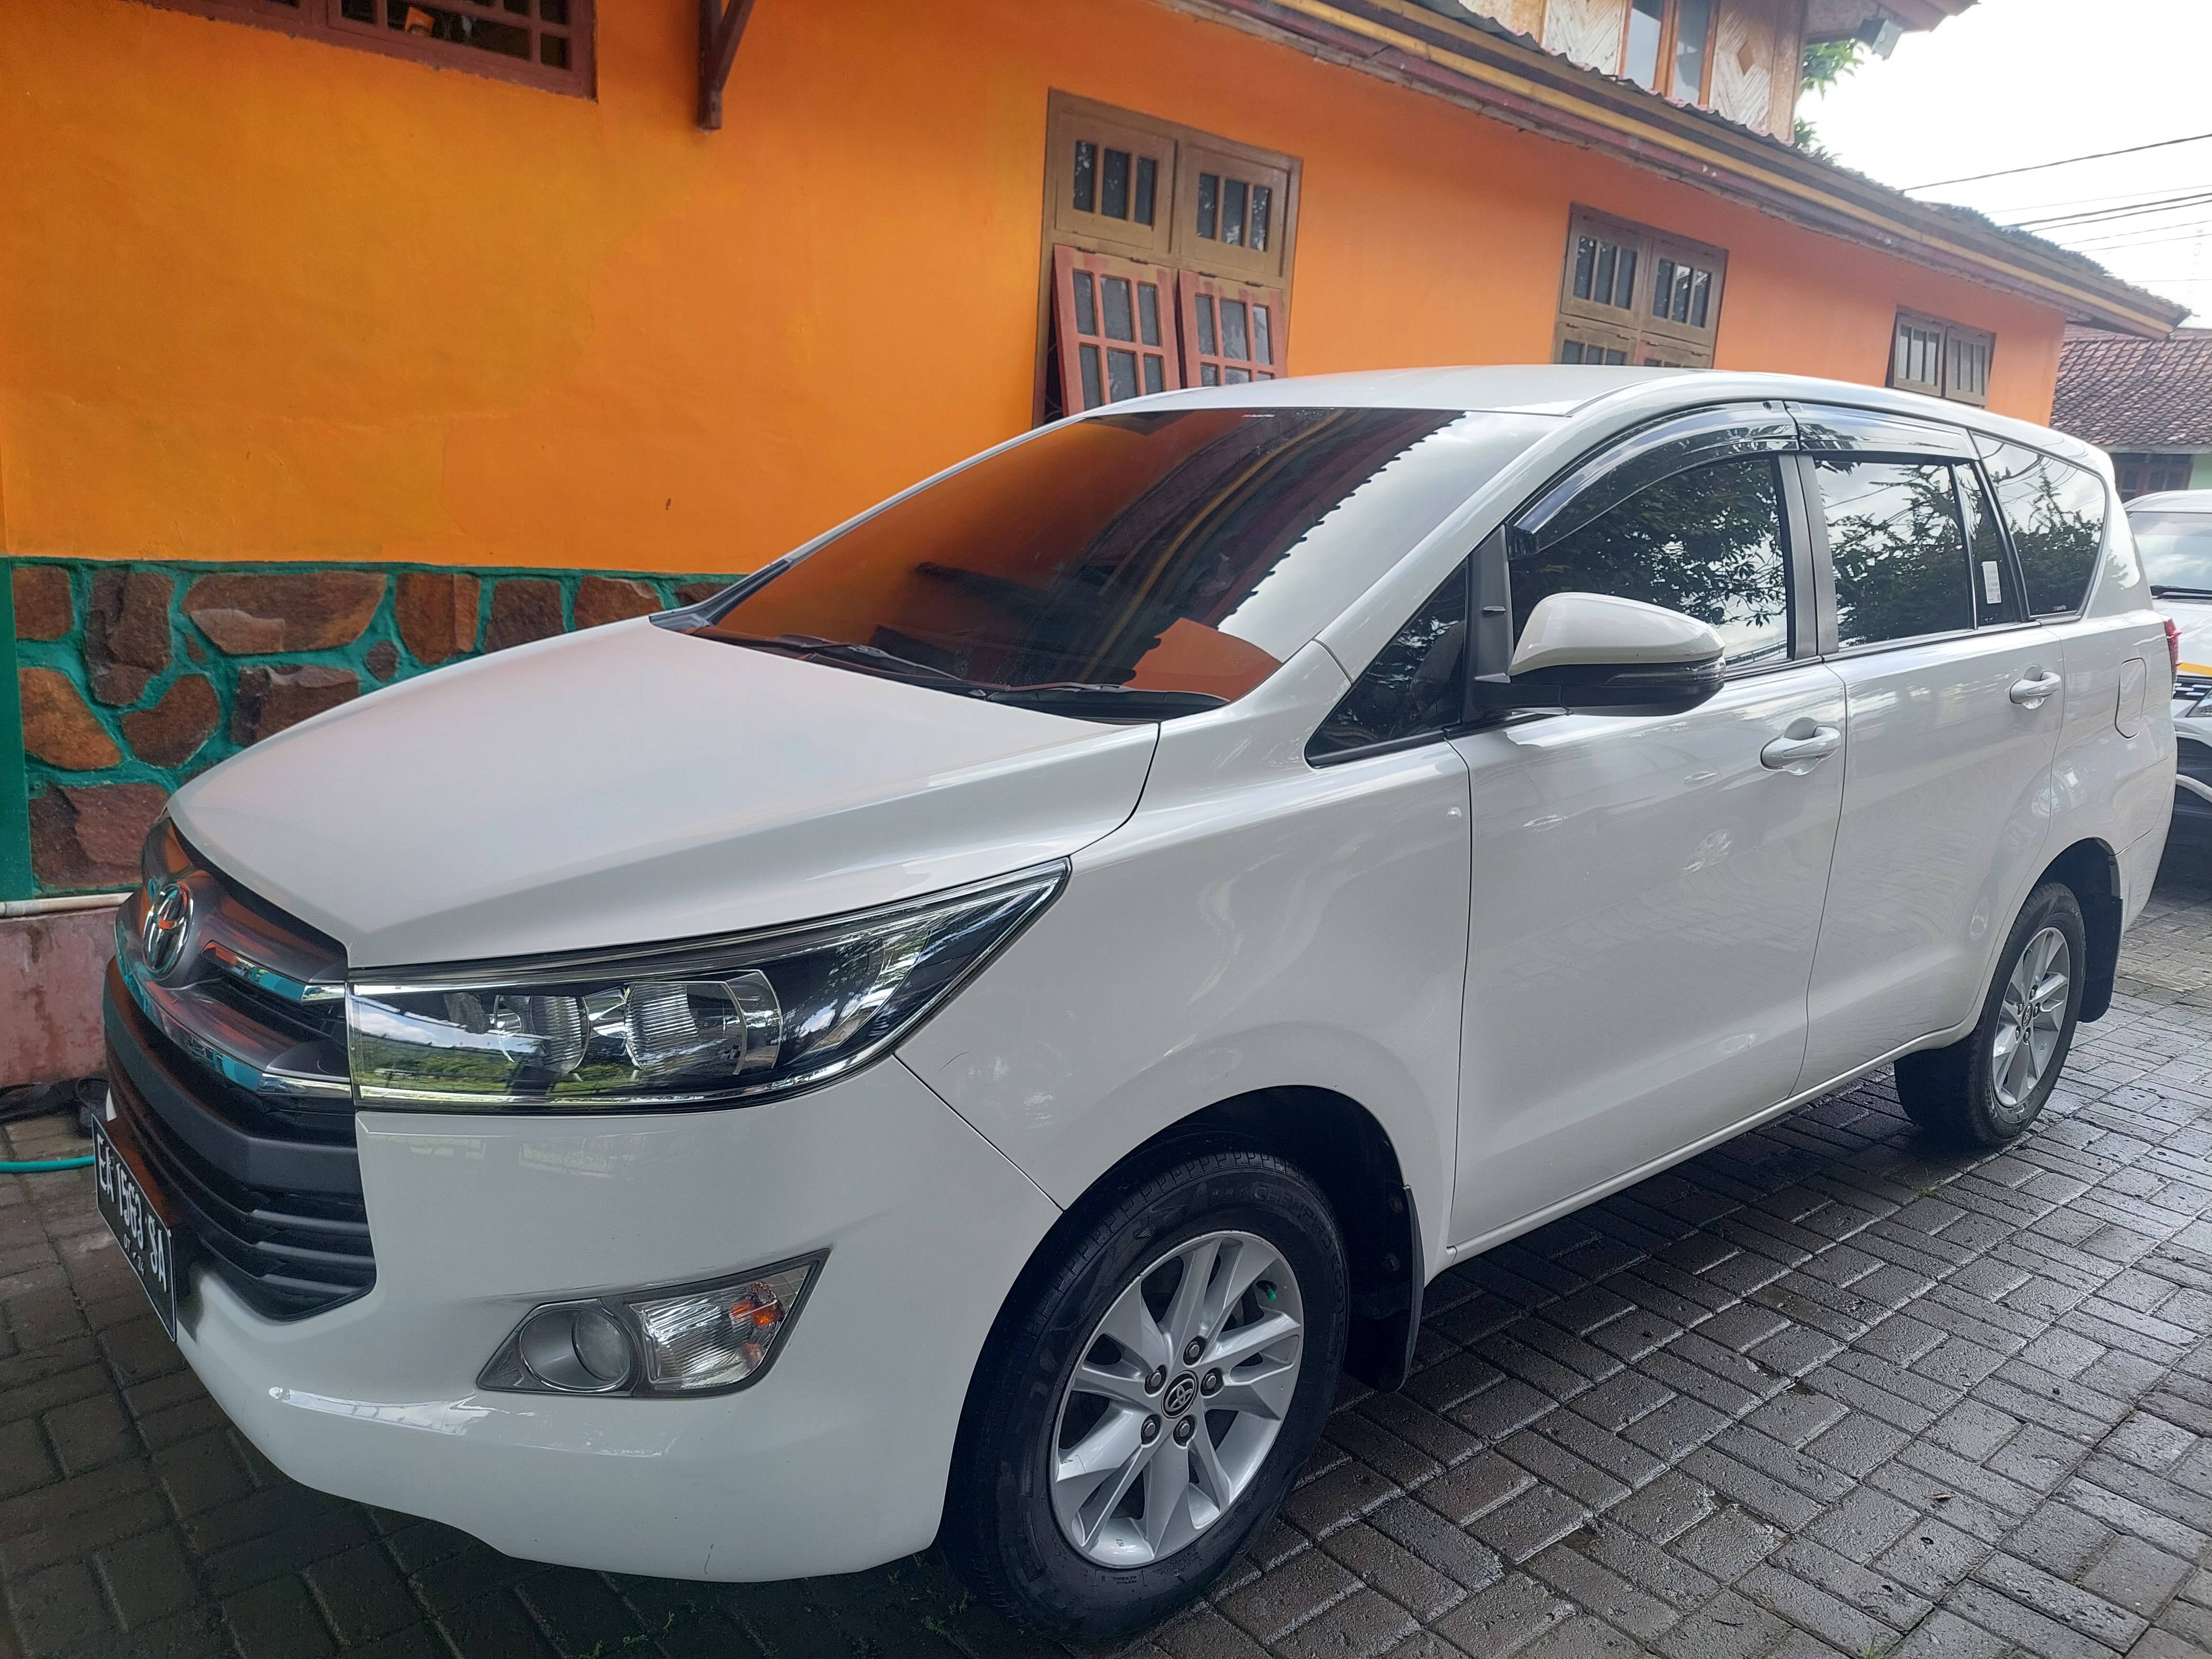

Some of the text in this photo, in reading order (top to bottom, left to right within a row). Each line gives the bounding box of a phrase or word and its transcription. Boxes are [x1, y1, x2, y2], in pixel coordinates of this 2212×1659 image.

[97, 1133, 167, 1293] EA 1563 SA
[123, 1233, 131, 1253] 07
